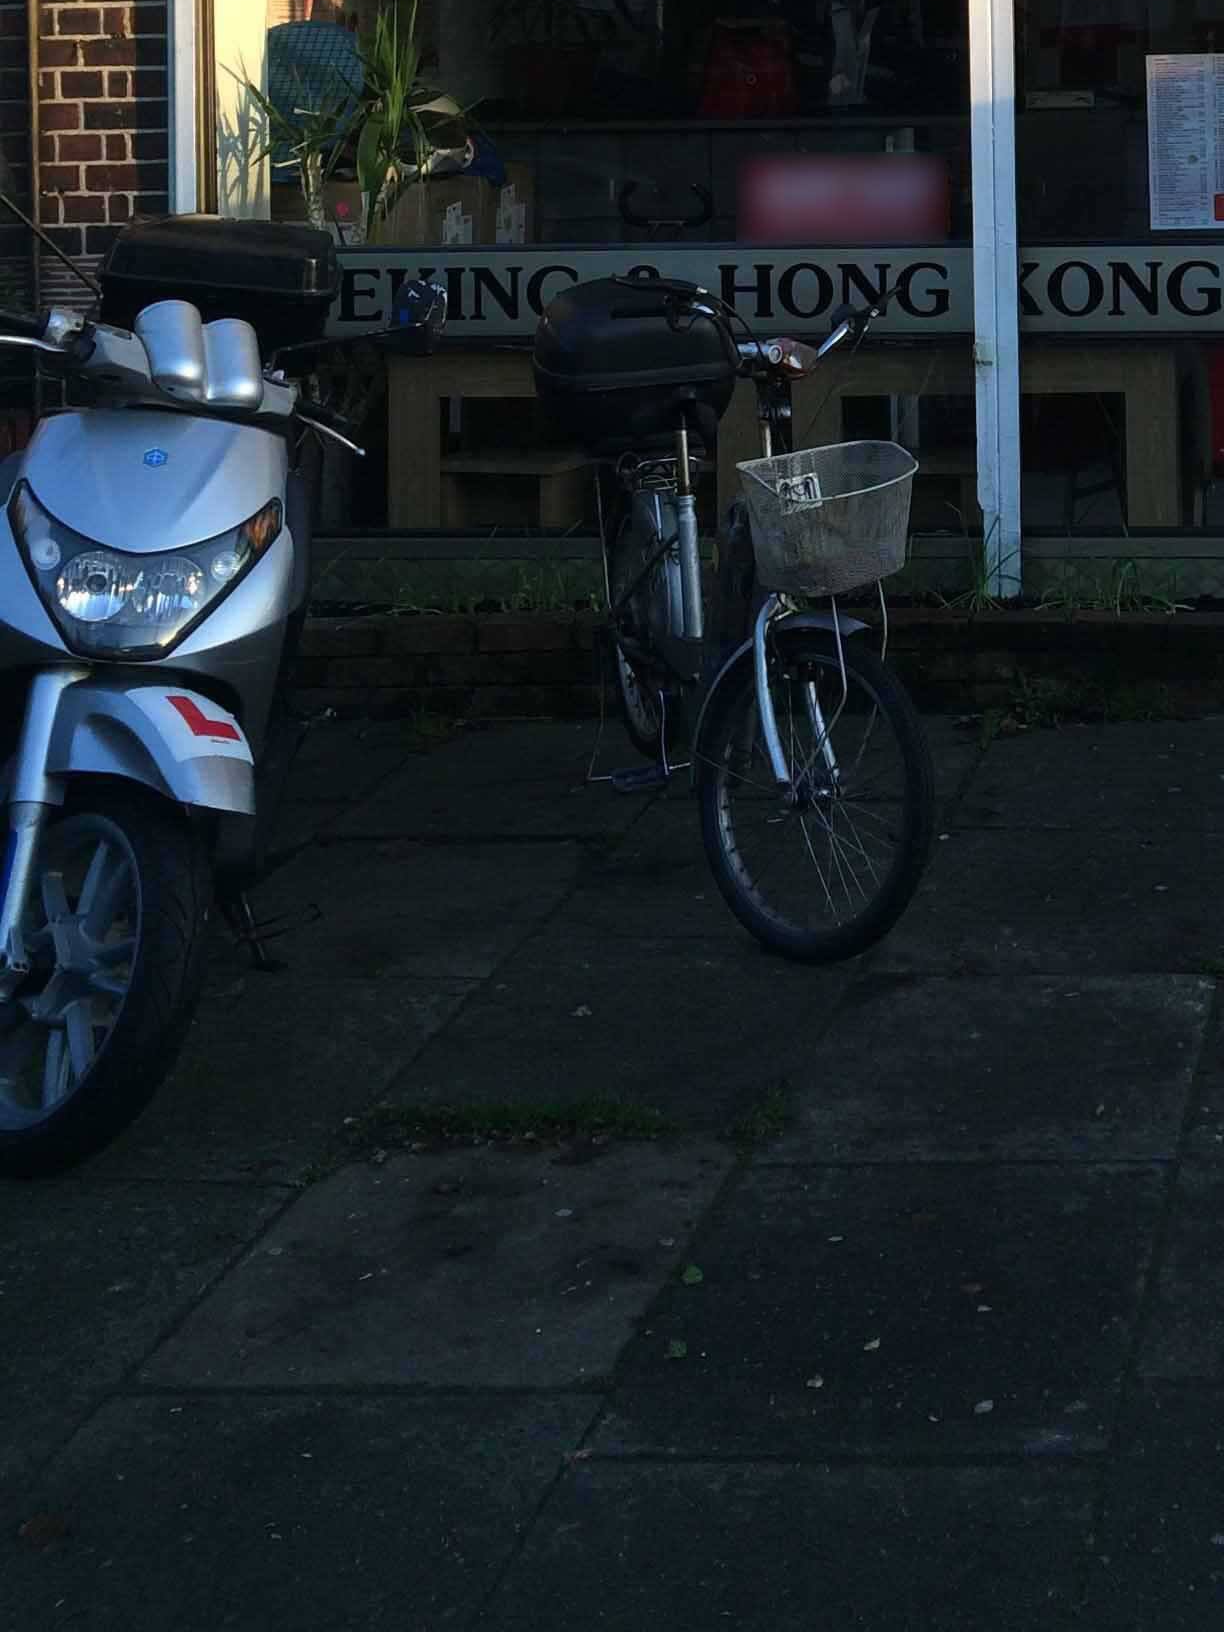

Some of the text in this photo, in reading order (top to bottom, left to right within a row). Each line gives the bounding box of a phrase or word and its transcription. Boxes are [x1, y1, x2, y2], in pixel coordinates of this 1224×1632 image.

[337, 264, 580, 322] EING
[718, 261, 951, 324] HONG
[1016, 258, 1223, 317] KONG
[165, 695, 241, 742] L
